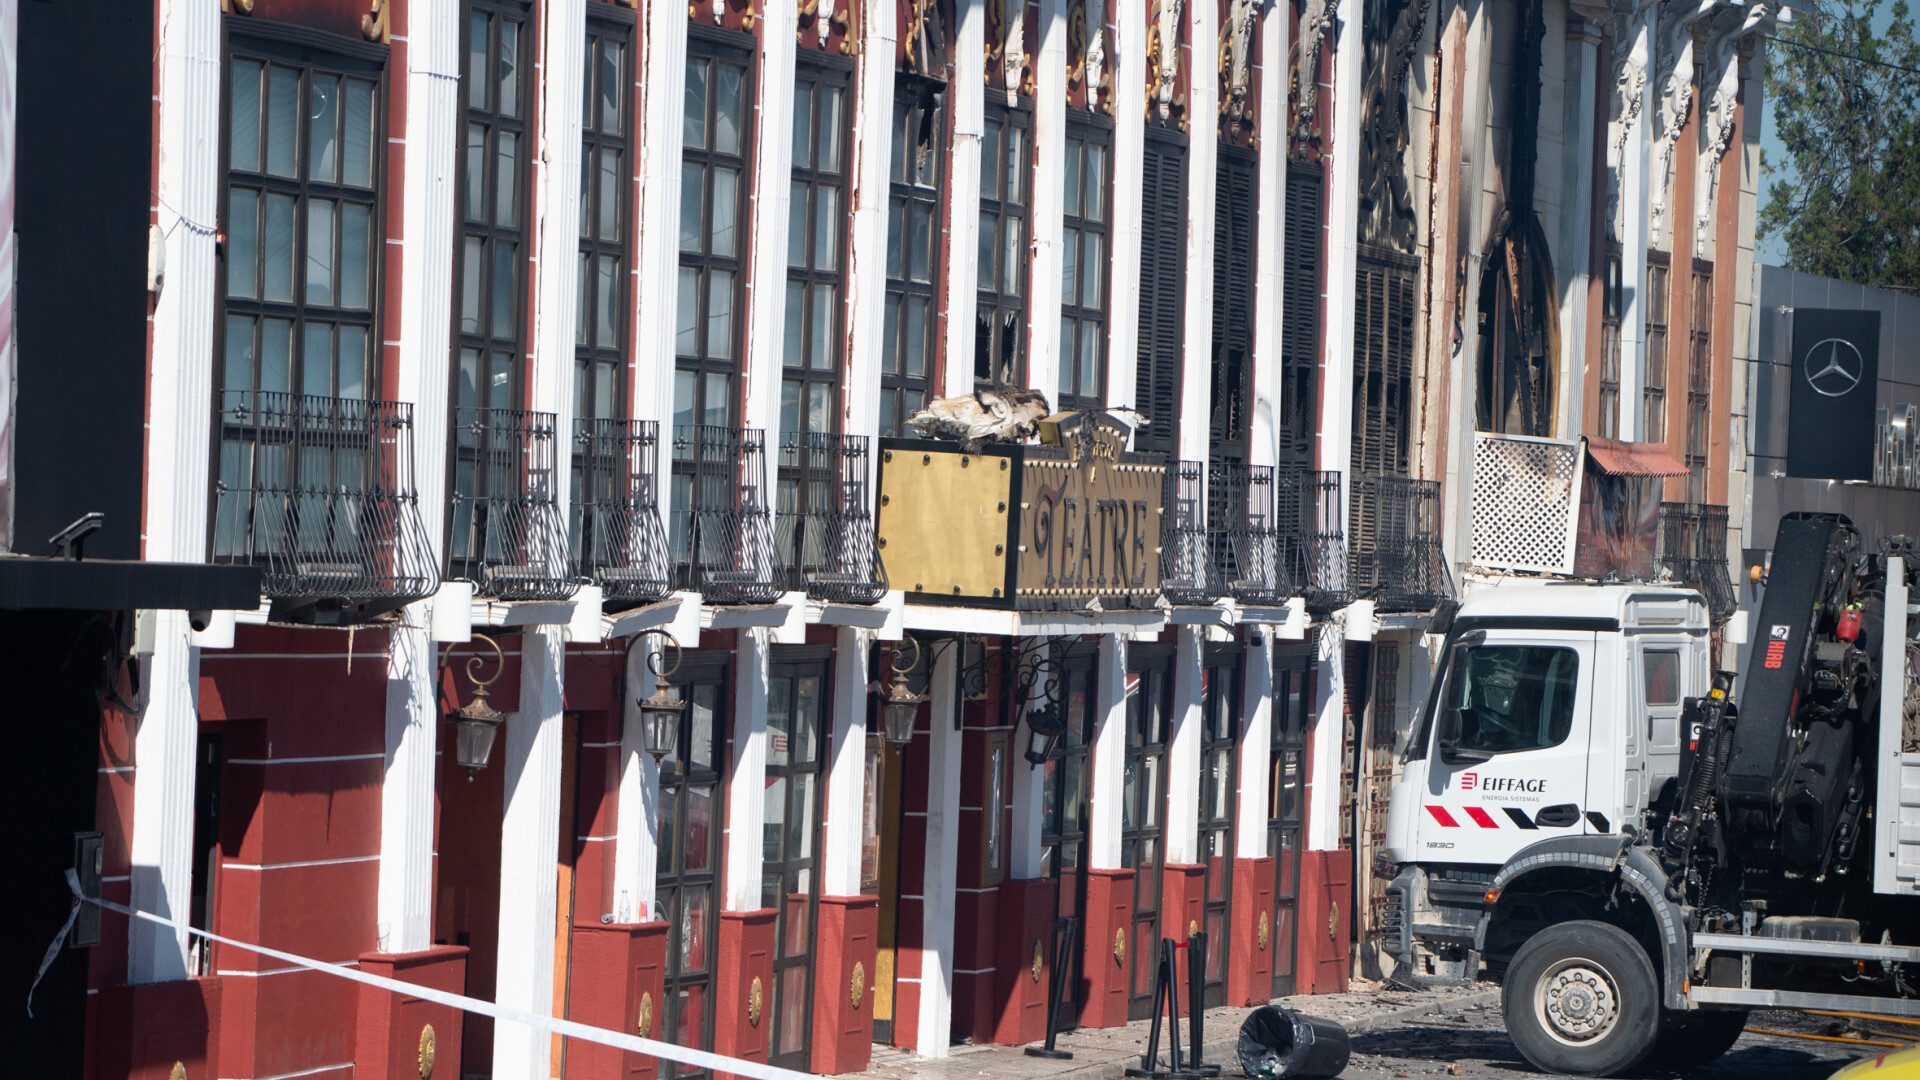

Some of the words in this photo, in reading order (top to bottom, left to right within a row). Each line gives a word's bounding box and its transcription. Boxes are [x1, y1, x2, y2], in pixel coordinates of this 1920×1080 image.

[1034, 475, 1147, 588] TEATRE
[1765, 641, 1786, 669] HIAB
[1482, 777, 1548, 793] EIFFAGE
[1482, 794, 1508, 802] ENERGÍA
[1426, 841, 1455, 849] 1830
